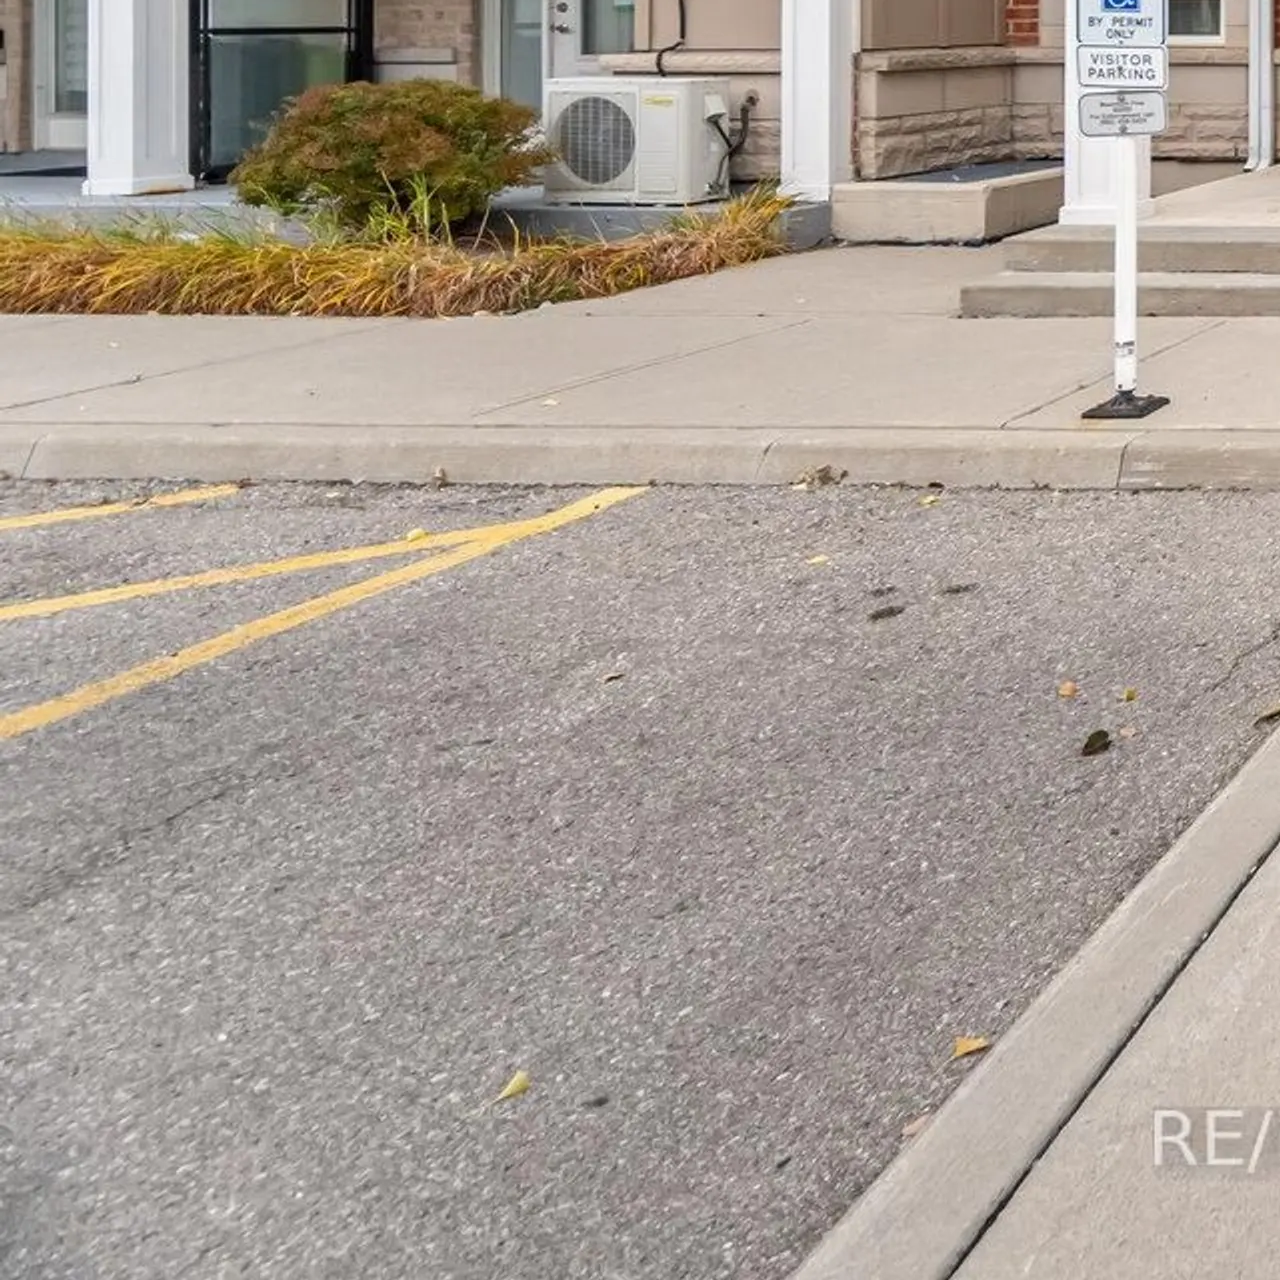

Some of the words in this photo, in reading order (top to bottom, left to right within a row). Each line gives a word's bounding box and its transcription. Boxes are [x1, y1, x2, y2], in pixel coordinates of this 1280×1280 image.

[1088, 16, 1103, 27] BY
[1112, 16, 1153, 27] PERMIT
[1106, 28, 1135, 39] ONLY
[1090, 53, 1152, 66] VISITOR
[1088, 67, 1156, 80] PARKING
